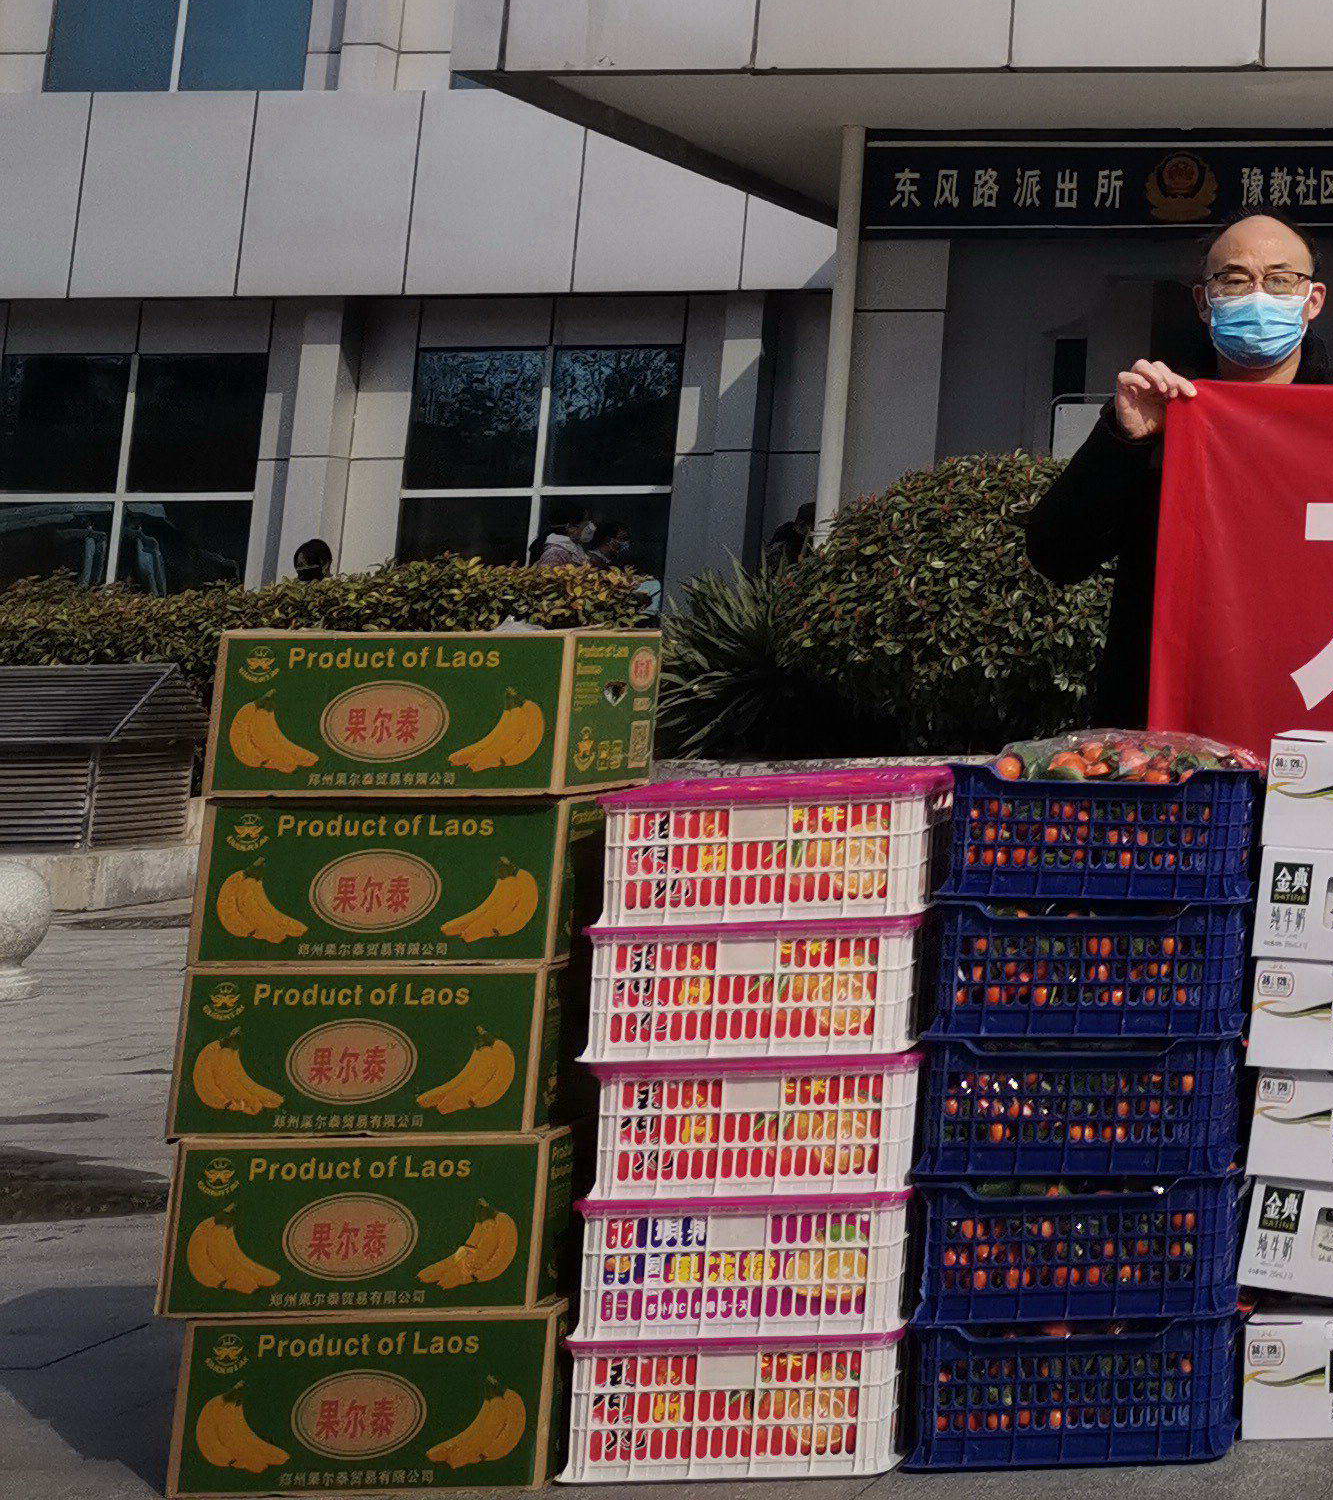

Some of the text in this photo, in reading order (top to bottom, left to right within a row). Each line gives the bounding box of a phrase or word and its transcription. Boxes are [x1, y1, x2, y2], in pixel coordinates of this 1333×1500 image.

[890, 167, 1124, 209] 东风路派出所
[289, 646, 500, 670] Product of Laos
[278, 814, 494, 838] Product of Laos
[254, 982, 470, 1007] Product of Laos
[249, 1155, 472, 1181] Product of Laos
[257, 1331, 480, 1358] Product of Laos
